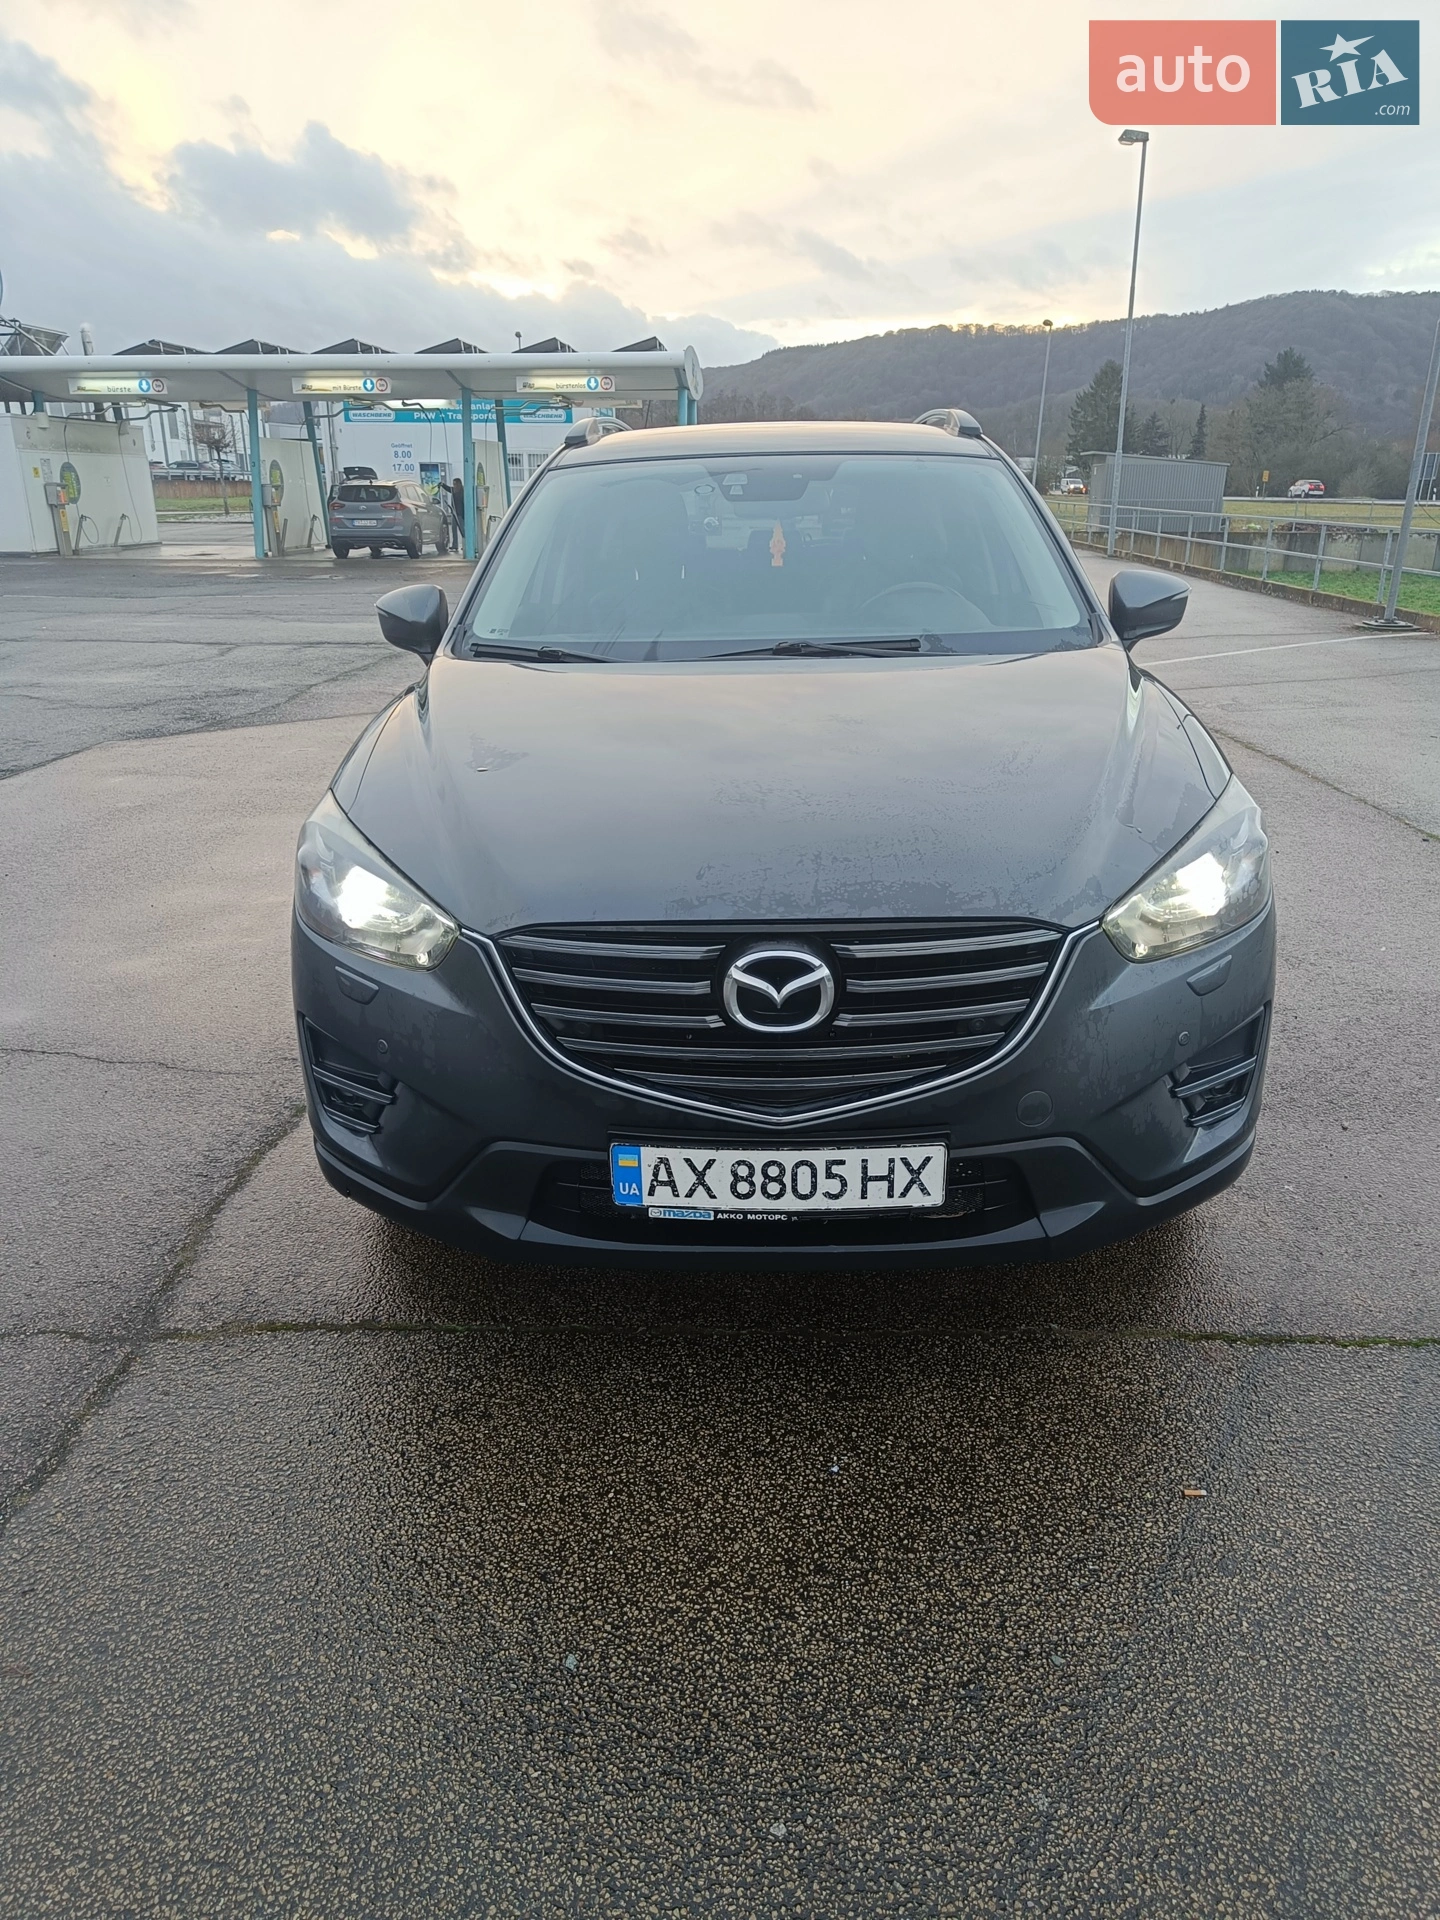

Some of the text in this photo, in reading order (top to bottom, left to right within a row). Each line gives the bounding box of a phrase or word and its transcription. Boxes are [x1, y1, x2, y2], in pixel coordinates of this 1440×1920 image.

[106, 385, 132, 393] bürste
[413, 412, 436, 420] PKW
[393, 450, 412, 459] 8.00
[392, 463, 415, 472] 17.00
[647, 1155, 934, 1201] AX 8805 HX
[619, 1183, 640, 1196] UA
[662, 1209, 712, 1220] mazda
[716, 1212, 744, 1220] АККО
[746, 1213, 788, 1221] МОТОРС
